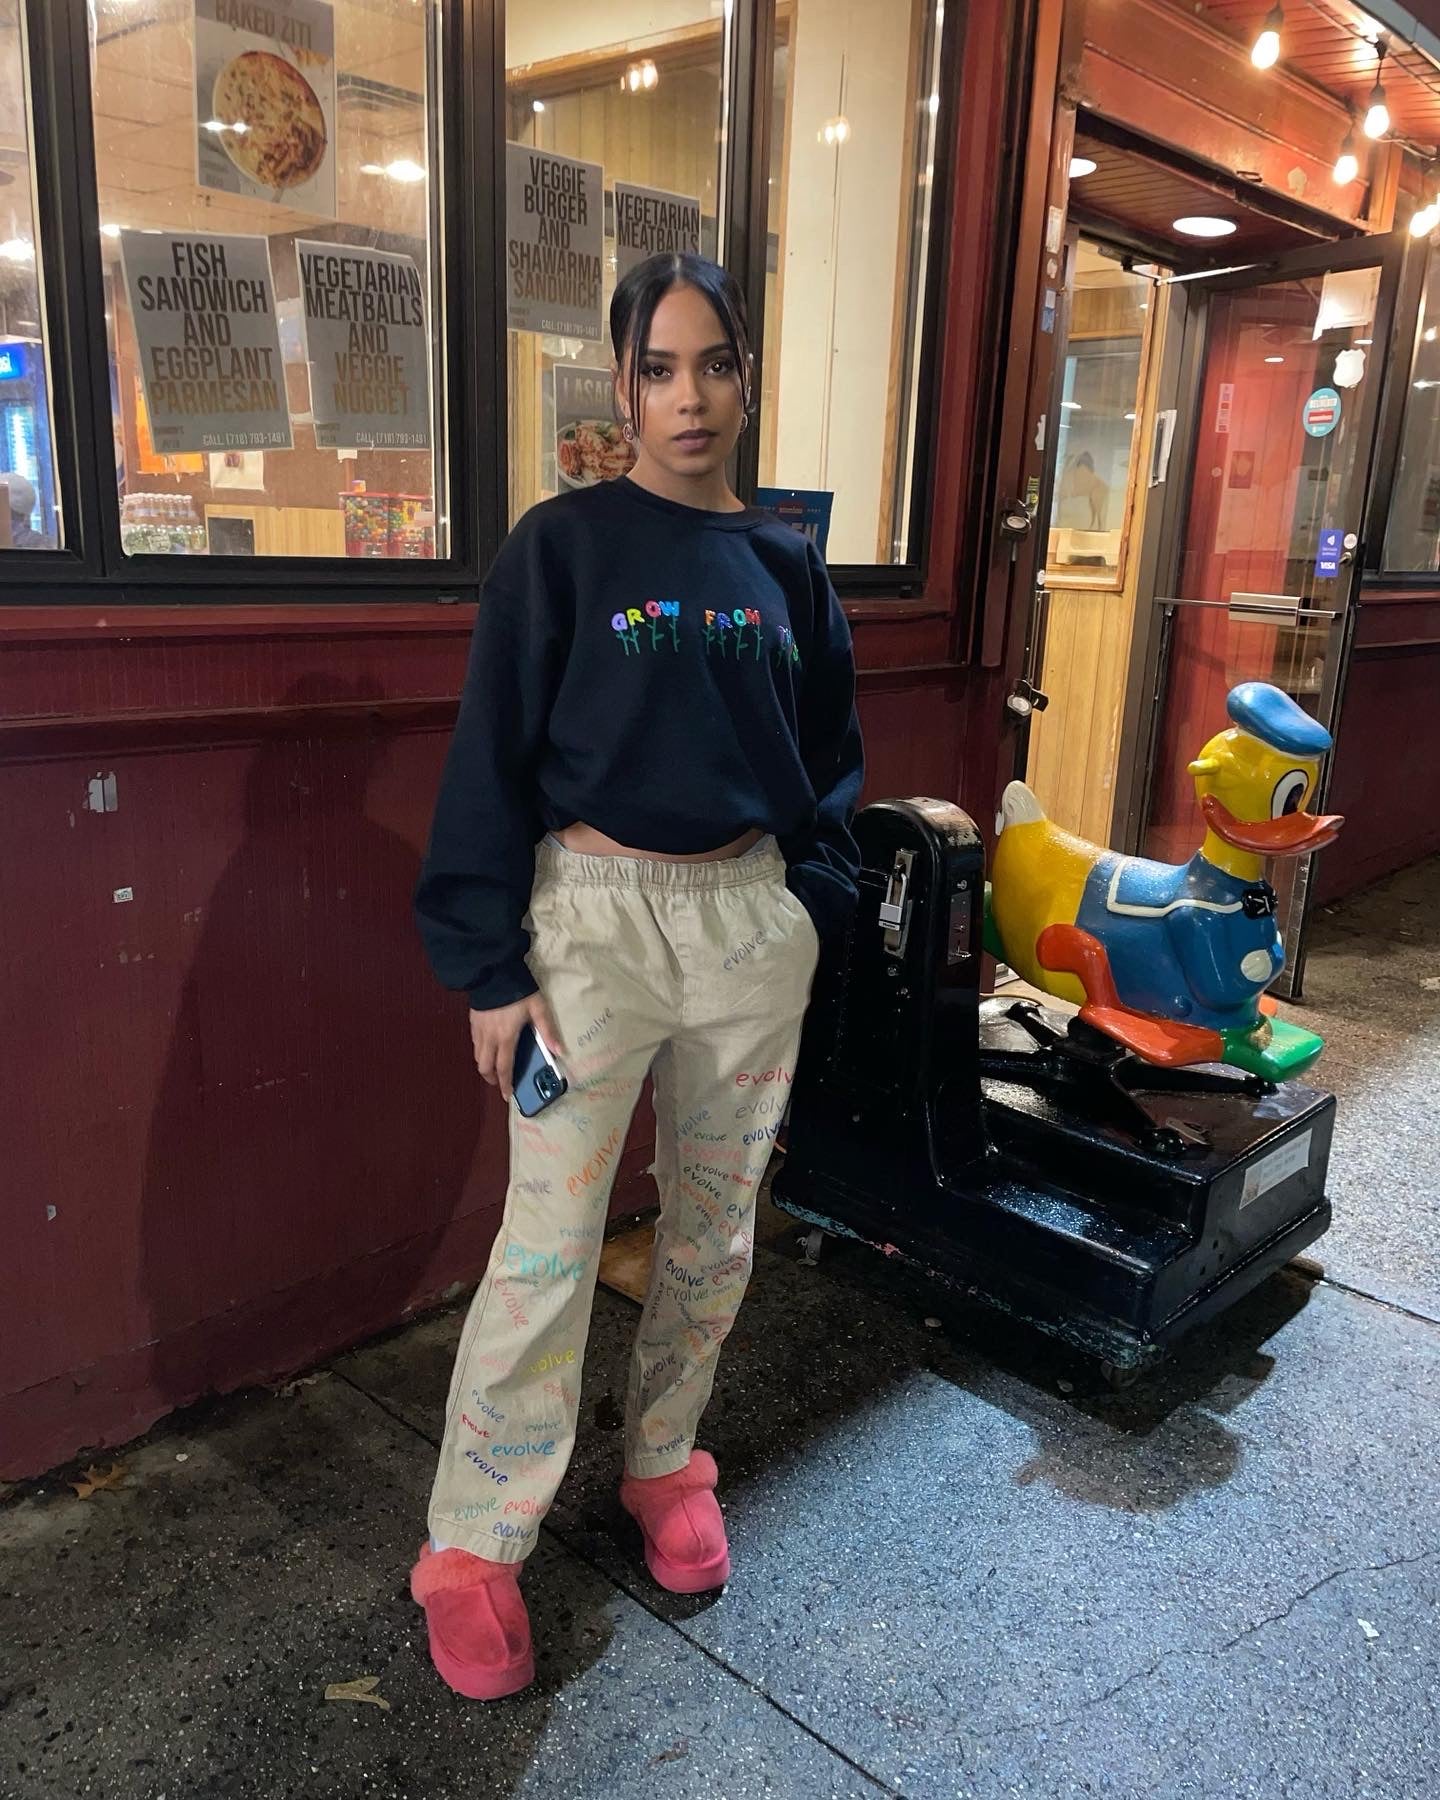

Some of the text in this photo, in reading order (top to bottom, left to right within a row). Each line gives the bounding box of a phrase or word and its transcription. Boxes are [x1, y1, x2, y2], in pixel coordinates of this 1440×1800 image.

[215, 0, 312, 50] BAKED ZITI
[529, 156, 586, 198] VEGGIE
[524, 184, 588, 226] BURGER
[615, 191, 700, 233] VEGETARIAN
[538, 217, 571, 250] AND
[618, 220, 700, 256] MEATBALLS
[171, 242, 228, 278] FISH
[299, 252, 422, 298] VEGETARIAN
[508, 239, 603, 285] SHAWARMA
[137, 275, 268, 314] SANDWICH
[305, 287, 424, 327] MEATBALLS
[514, 270, 600, 310] SANDWICH
[183, 312, 232, 347] AND
[348, 323, 389, 354] AND
[151, 346, 274, 381] EGGPLANT
[334, 352, 404, 385] VEGGIE
[150, 380, 280, 416] PARMESAN
[333, 383, 411, 416] NUGGET
[563, 377, 613, 410] LASAG
[203, 432, 225, 447] CALL
[1320, 561, 1335, 571] VISA
[611, 600, 680, 632] GROW
[704, 608, 762, 629] FROM
[722, 930, 769, 972] evolve
[576, 1007, 613, 1048] evolve
[735, 1067, 792, 1088] evolv
[735, 1096, 785, 1120] evolv
[742, 1120, 783, 1146] evolv
[566, 1127, 621, 1198] evolve
[695, 1162, 729, 1181] evolve
[683, 1166, 722, 1200] evolve
[504, 1242, 587, 1281] evolve
[666, 1258, 704, 1288] evolve
[471, 1389, 505, 1424] evolve
[490, 1440, 556, 1457] evolve
[465, 1449, 509, 1486] evolve
[454, 1496, 500, 1521] evolve
[503, 1497, 548, 1515] evolv
[492, 1521, 535, 1539] evolv
